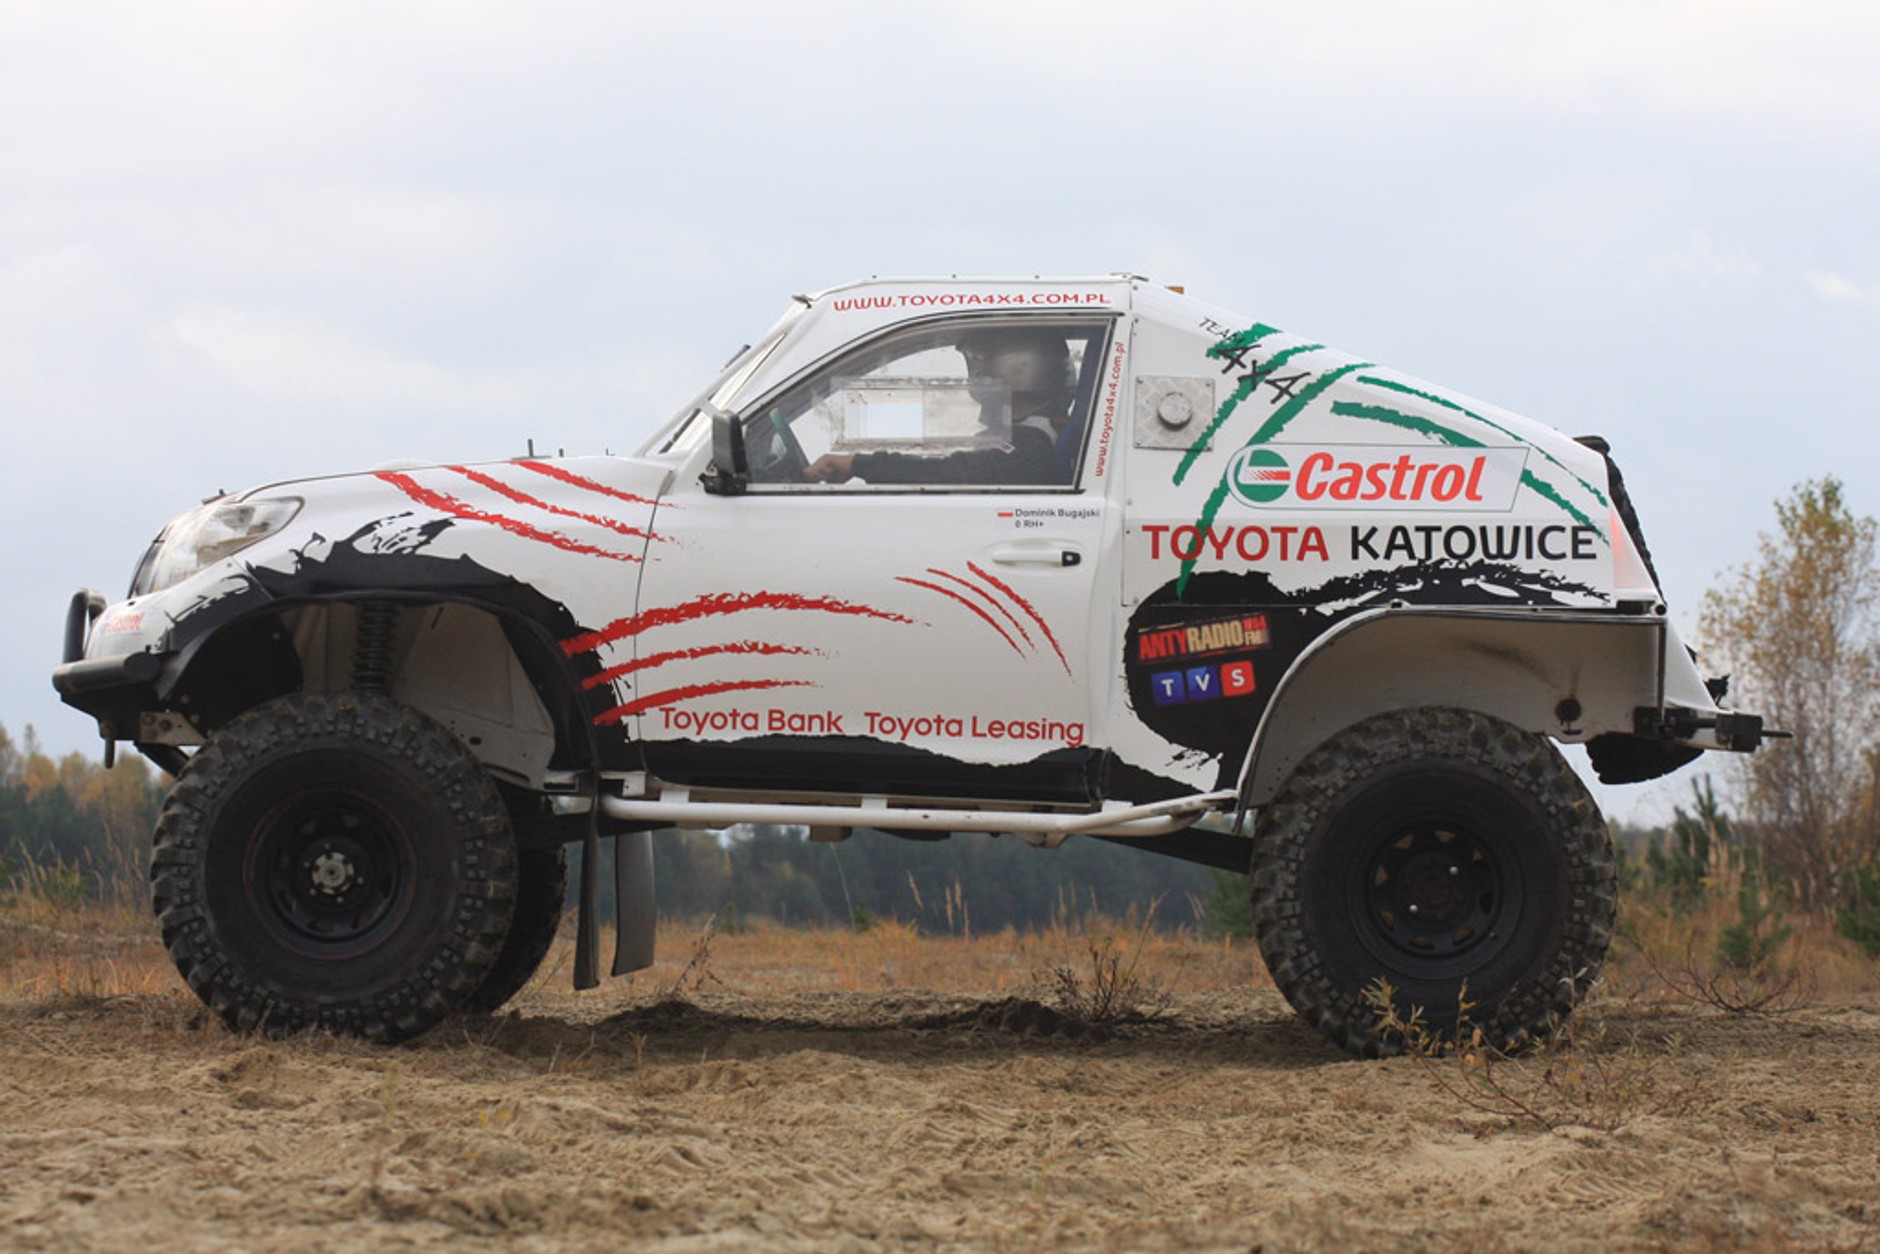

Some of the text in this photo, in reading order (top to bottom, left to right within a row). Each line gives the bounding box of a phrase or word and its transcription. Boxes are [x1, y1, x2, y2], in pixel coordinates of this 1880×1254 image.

[834, 294, 1111, 311] WWW.TOYOTA4X4.COM.PL
[1095, 341, 1125, 477] www.toyota4x4.com.pl
[1295, 452, 1486, 501] Castrol
[1015, 509, 1100, 519] Dominik Bugajski
[1142, 525, 1598, 561] TOYOTA KATOWICE
[659, 707, 1084, 747] Toyota Bank Toyota Leasing
